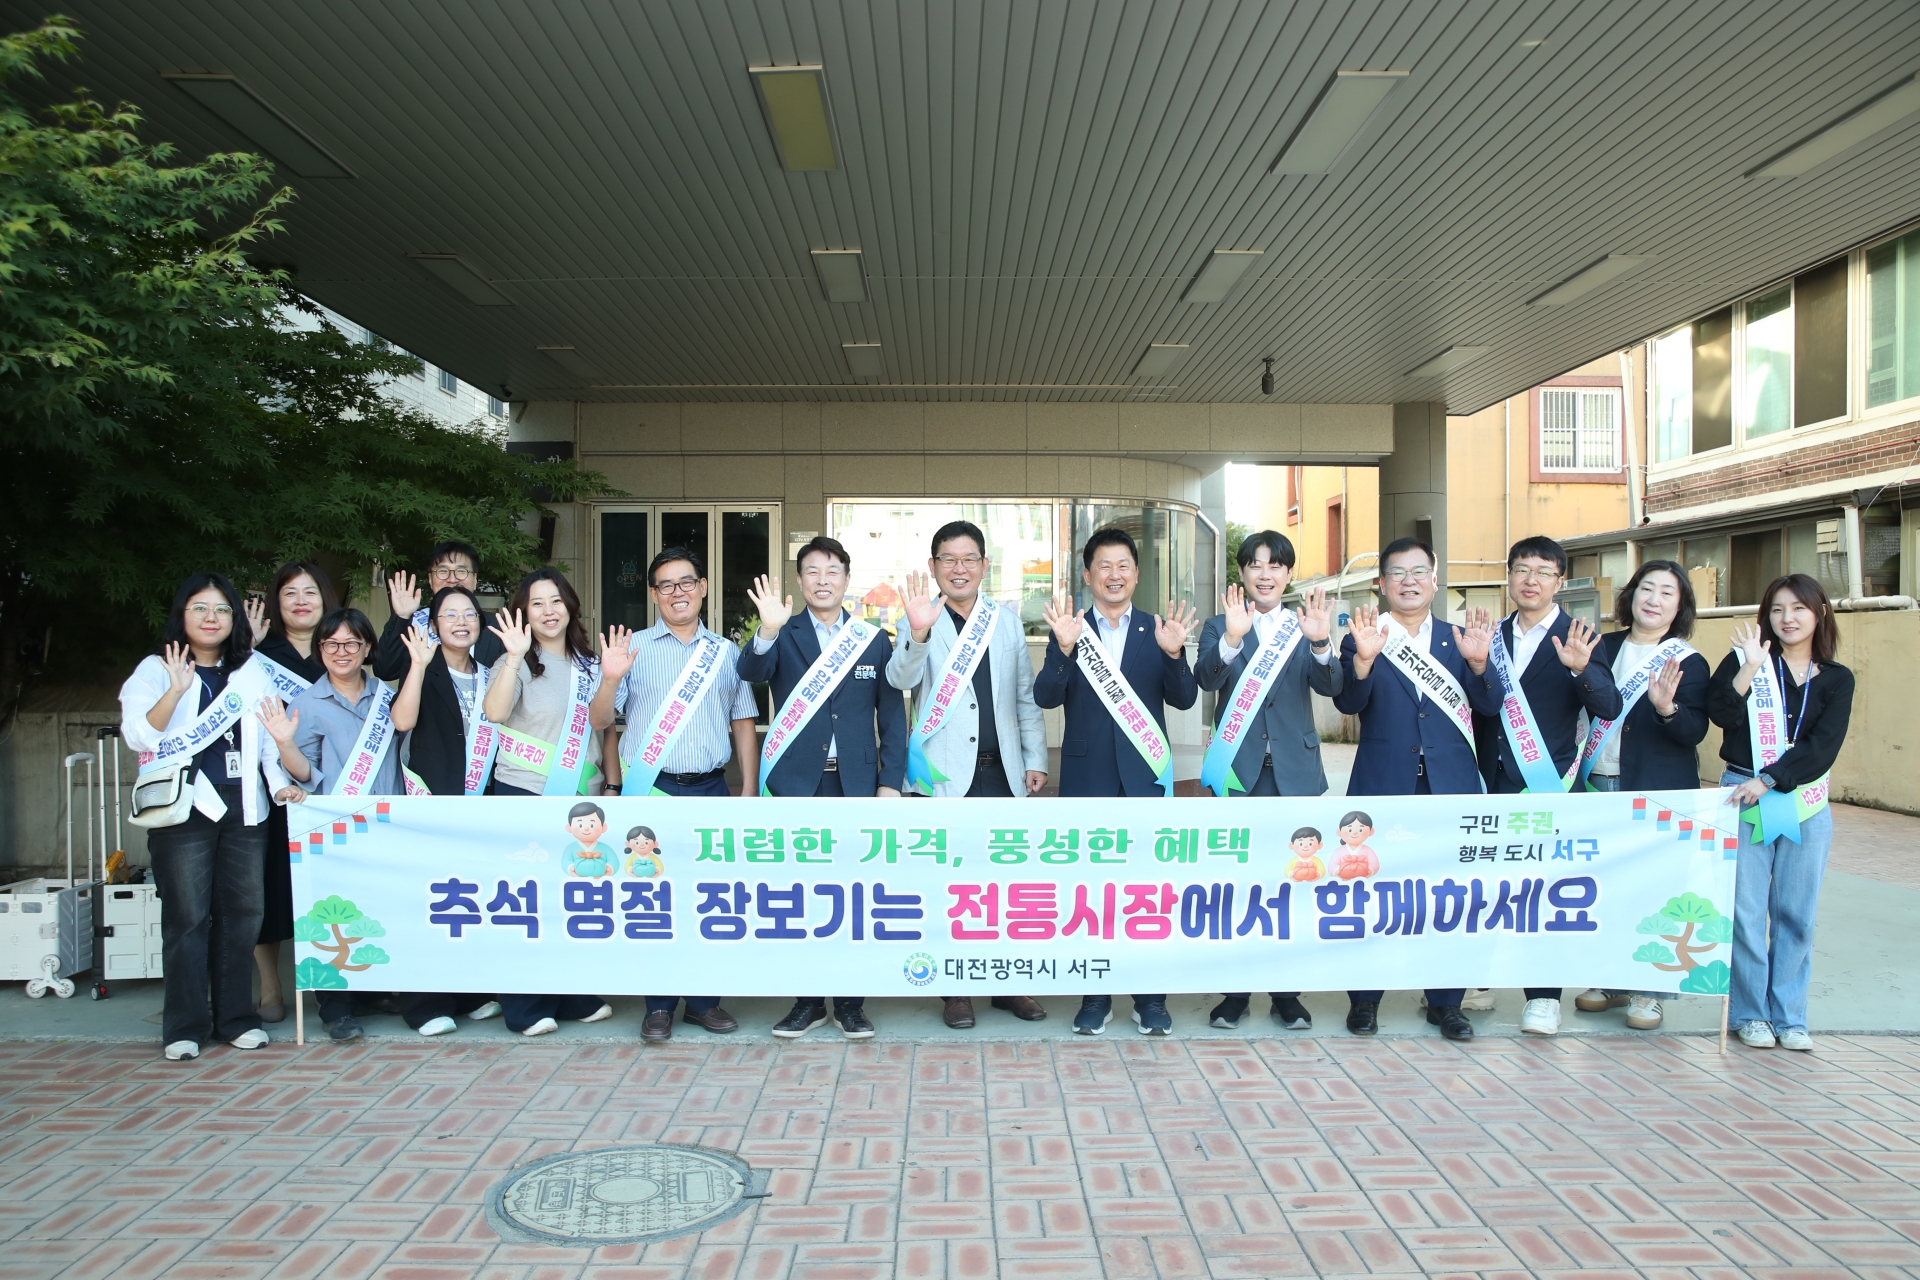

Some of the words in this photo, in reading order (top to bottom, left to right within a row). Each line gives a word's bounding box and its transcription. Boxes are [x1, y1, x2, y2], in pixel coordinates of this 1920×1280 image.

[967, 607, 992, 646] 지역물가
[1269, 616, 1298, 651] 지역물가
[696, 641, 721, 674] 지역물가
[824, 635, 858, 674] 지역물가
[951, 643, 976, 676] 안정에
[1253, 650, 1279, 680] 안정에
[678, 670, 705, 703] 안정에
[801, 670, 831, 702] 안정에
[935, 673, 960, 707] 동참해
[1397, 645, 1445, 691] 바가지요금
[1439, 685, 1461, 709] 근절
[1752, 677, 1773, 709] 안정에
[1077, 636, 1112, 683] 바가지요금
[1103, 681, 1127, 704] 근절
[1117, 700, 1148, 733] 함께해
[1140, 729, 1165, 761] 주세요
[1236, 678, 1262, 712] 동참해
[185, 707, 229, 745] 지역물가
[570, 704, 588, 736] 동참해
[658, 700, 686, 734] 동참해
[781, 698, 809, 732] 동참해
[920, 704, 945, 735] 주세요
[1221, 710, 1246, 744] 주세요
[1503, 696, 1527, 729] 동참해
[1515, 729, 1542, 763] 주세요
[1758, 712, 1777, 746] 동참해
[364, 723, 386, 754] 안정에
[473, 725, 493, 757] 동참해
[514, 741, 546, 765] 주세요
[561, 736, 581, 770] 주세요
[642, 732, 667, 766] 주세요
[764, 727, 786, 761] 주세요
[1583, 727, 1604, 760] 주세요
[349, 752, 374, 785] 동참해
[465, 758, 485, 792] 주세요
[1459, 814, 1499, 834] 구민
[1506, 811, 1560, 836] 주권,
[694, 827, 837, 865] 저렴한
[859, 827, 963, 867] 가격,
[988, 827, 1133, 865] 풍성한
[1154, 827, 1251, 864] 혜택
[1459, 844, 1496, 863] 행복
[1503, 843, 1543, 862] 도시
[1551, 839, 1600, 861] 서구
[430, 877, 539, 938] 추석
[563, 879, 674, 940] 명절
[696, 881, 924, 941] 장보기는
[947, 882, 1291, 940] 전통시장에서
[1314, 876, 1598, 940] 함께하세요
[944, 958, 1057, 980] 대전광역시
[1068, 958, 1112, 980] 서구
